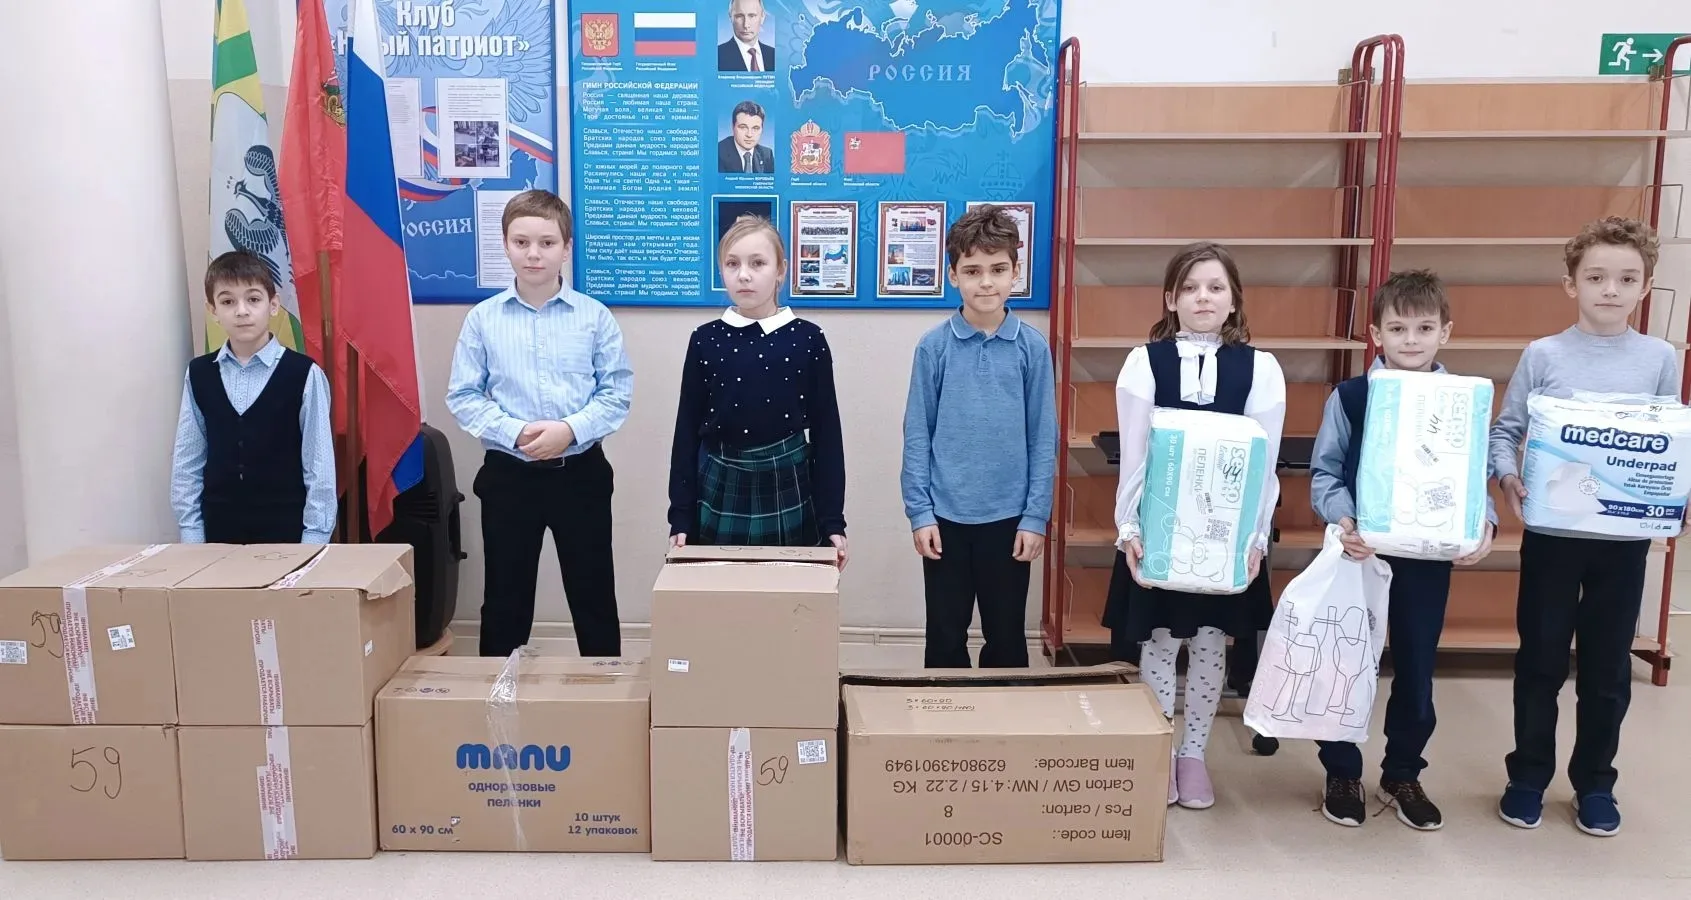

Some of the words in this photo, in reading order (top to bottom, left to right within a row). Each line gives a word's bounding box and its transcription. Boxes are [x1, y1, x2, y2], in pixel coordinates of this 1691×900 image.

[397, 0, 454, 30] Клуб
[418, 35, 530, 58] патриот»
[867, 64, 972, 82] РОССИЯ
[1563, 426, 1666, 451] medcare
[1606, 456, 1677, 472] Underpad
[1646, 506, 1664, 517] 30
[456, 744, 571, 772] manu
[1034, 758, 1099, 770] Barcode:
[1105, 758, 1134, 770] Item
[756, 755, 789, 786] 59
[885, 760, 1006, 772] 6298043901949
[69, 746, 122, 800] 59
[893, 781, 917, 793] KG
[926, 780, 958, 792] 2.22
[1054, 779, 1081, 792] GW
[1085, 779, 1134, 792] Carton
[944, 805, 953, 818] 8
[1042, 804, 1091, 816] carton:
[1105, 804, 1132, 816] Pcs
[574, 813, 588, 822] 10
[592, 814, 620, 823] штук
[392, 825, 406, 834] 60
[419, 825, 434, 834] 90
[568, 826, 582, 834] 12
[585, 826, 638, 836] упаковок
[1101, 829, 1131, 841] Item
[924, 832, 1003, 845] SC-00001
